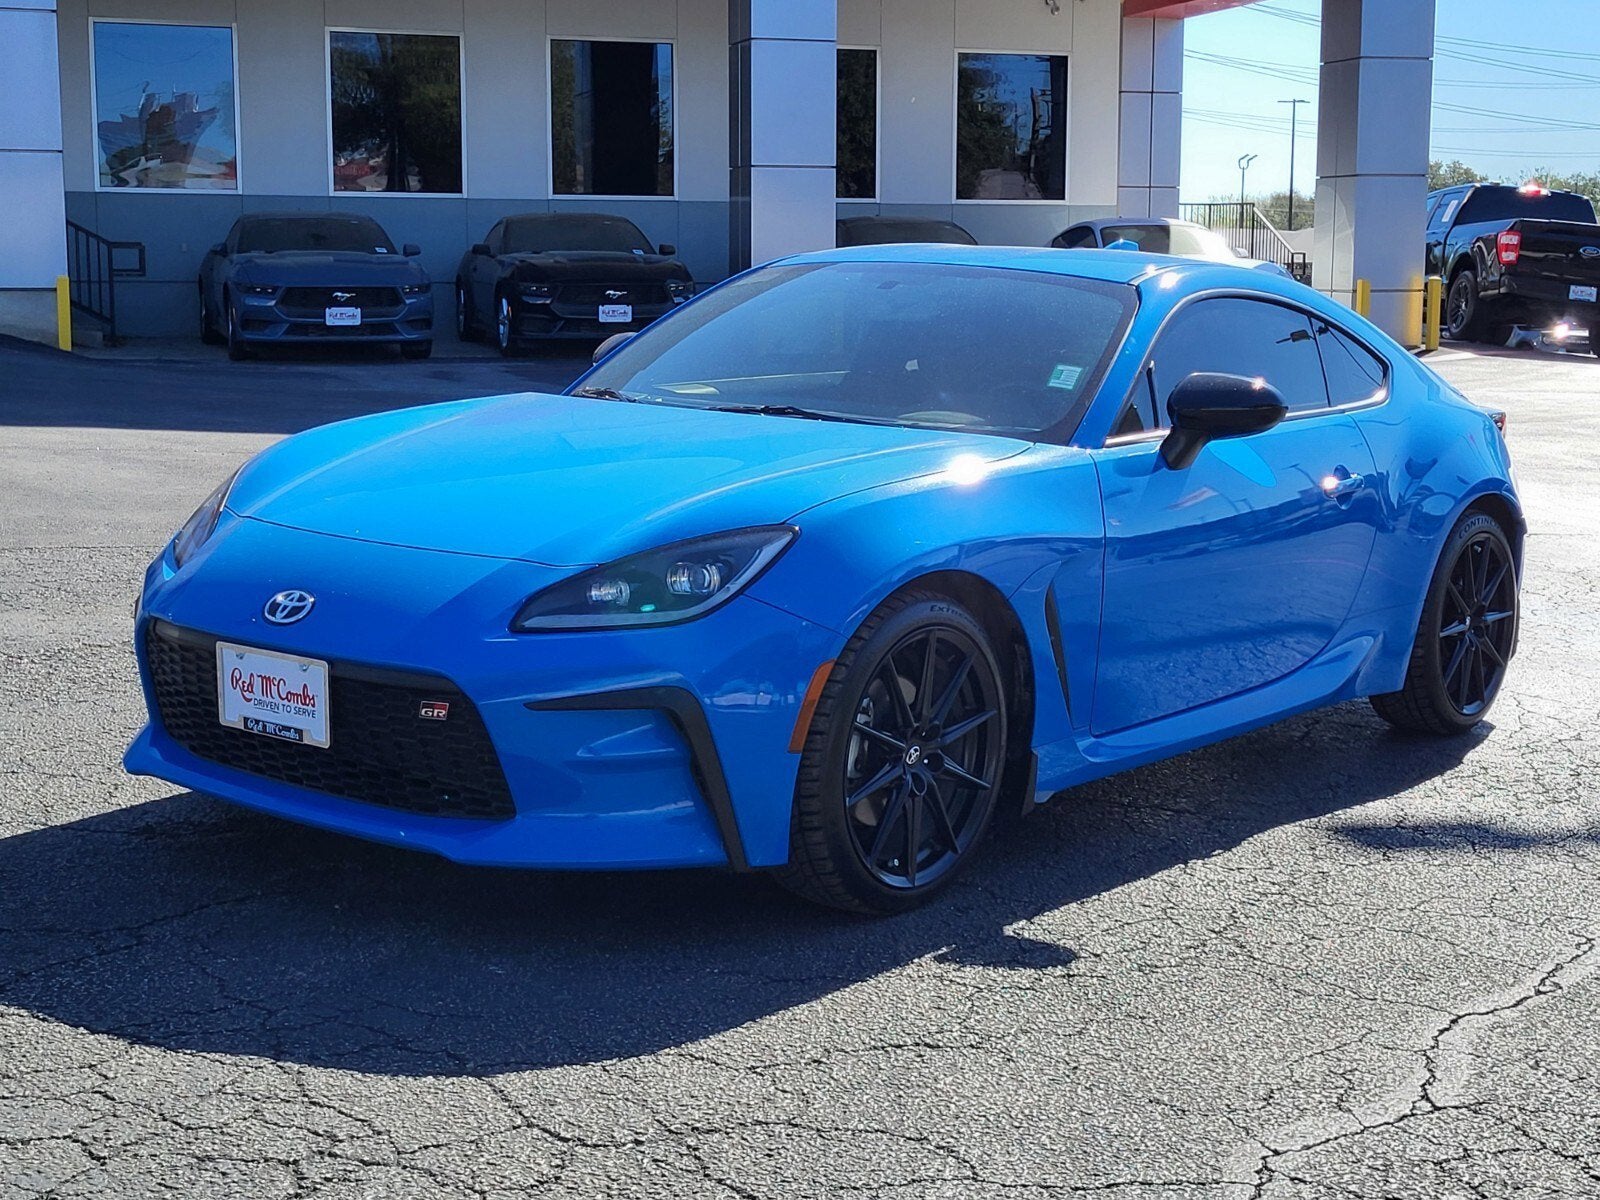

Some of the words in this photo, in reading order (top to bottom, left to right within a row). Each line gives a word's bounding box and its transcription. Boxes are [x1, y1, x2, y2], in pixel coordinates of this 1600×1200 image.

[231, 668, 255, 702] Red
[256, 673, 316, 708] McCombs
[254, 698, 279, 710] DRIVEN
[281, 704, 292, 714] TO
[294, 706, 316, 718] SERVE
[421, 708, 446, 718] GR
[248, 719, 262, 731] Red
[265, 723, 299, 739] McCombs
